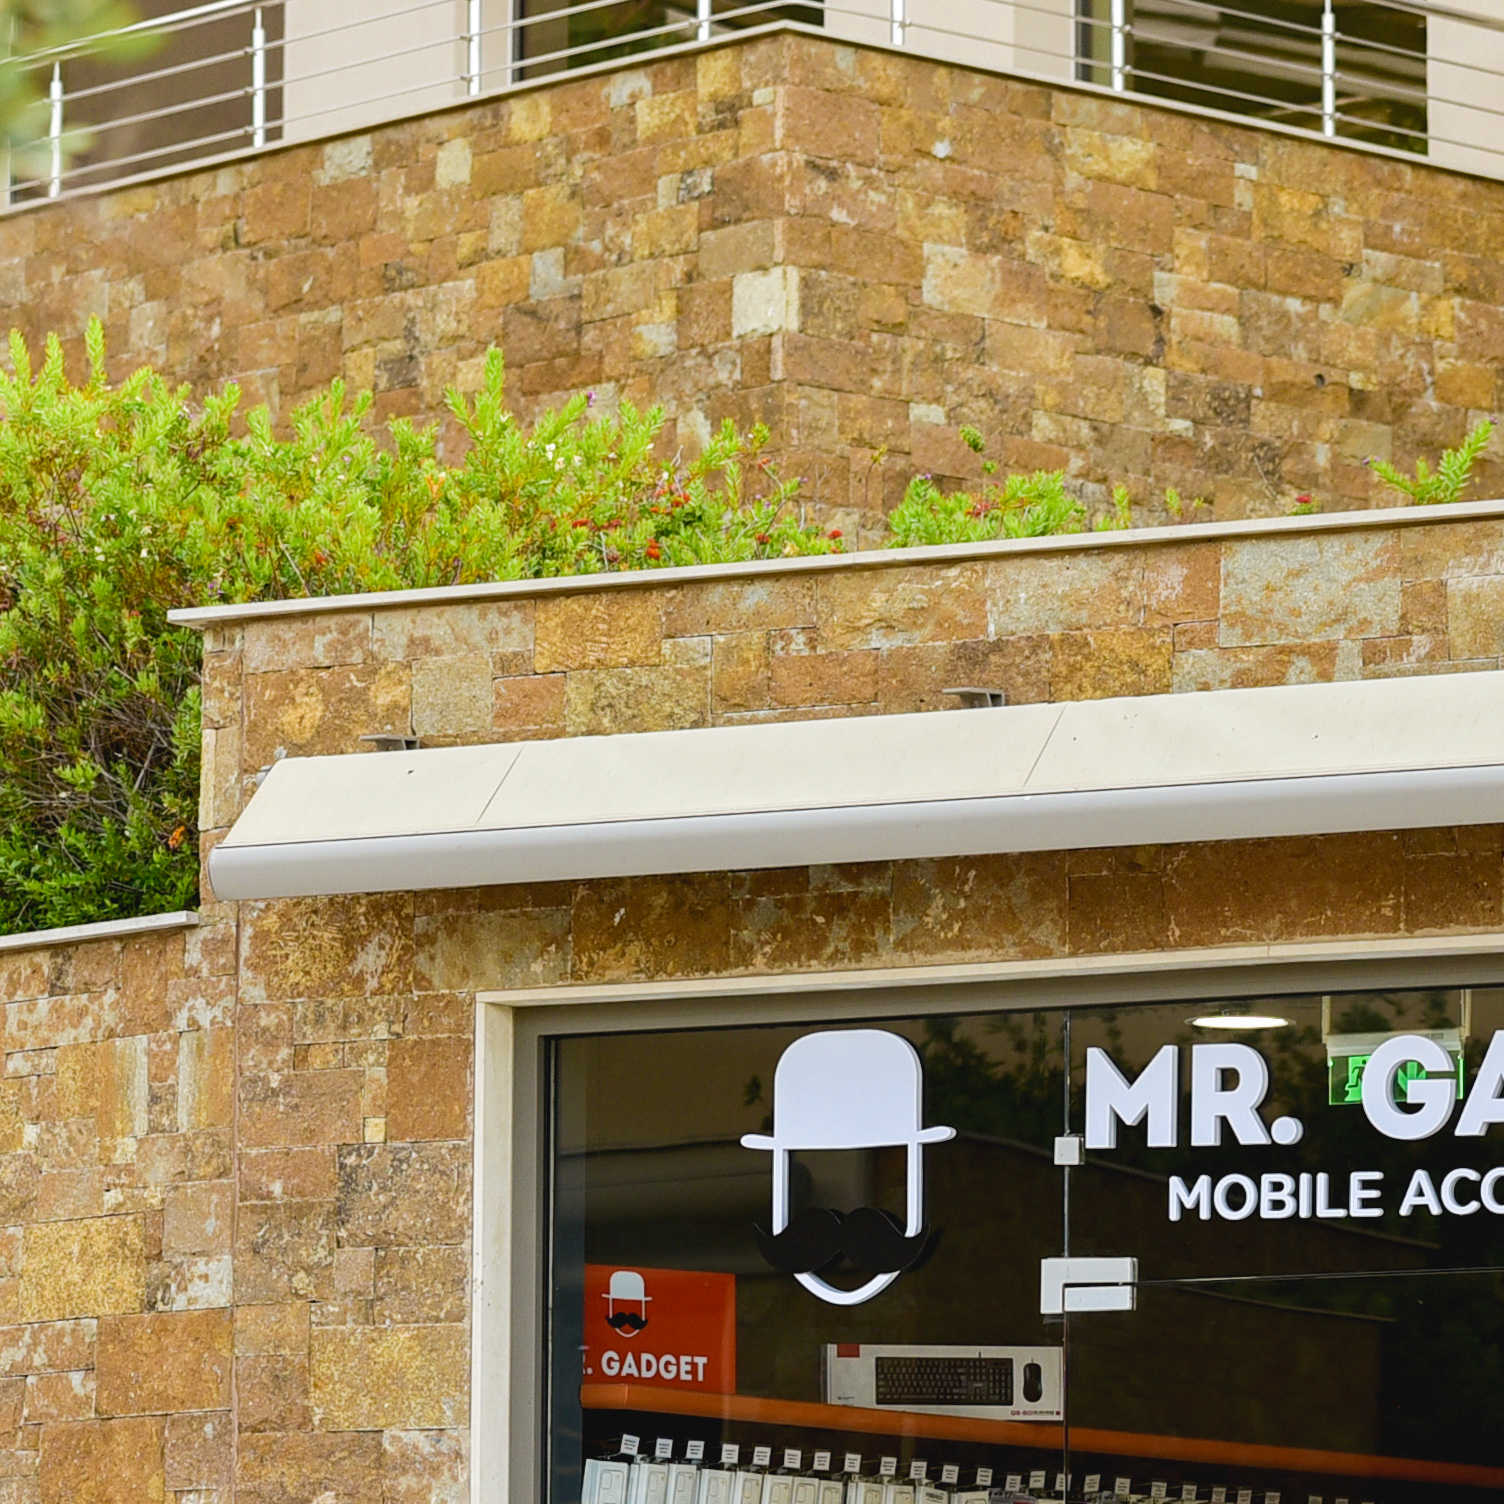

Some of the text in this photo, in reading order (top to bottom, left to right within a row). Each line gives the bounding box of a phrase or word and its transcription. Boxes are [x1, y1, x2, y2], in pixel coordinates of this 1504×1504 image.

[1085, 1043, 1303, 1149] MR.
[1168, 1171, 1384, 1222] MOBILE
[601, 1350, 708, 1382] GADGET
